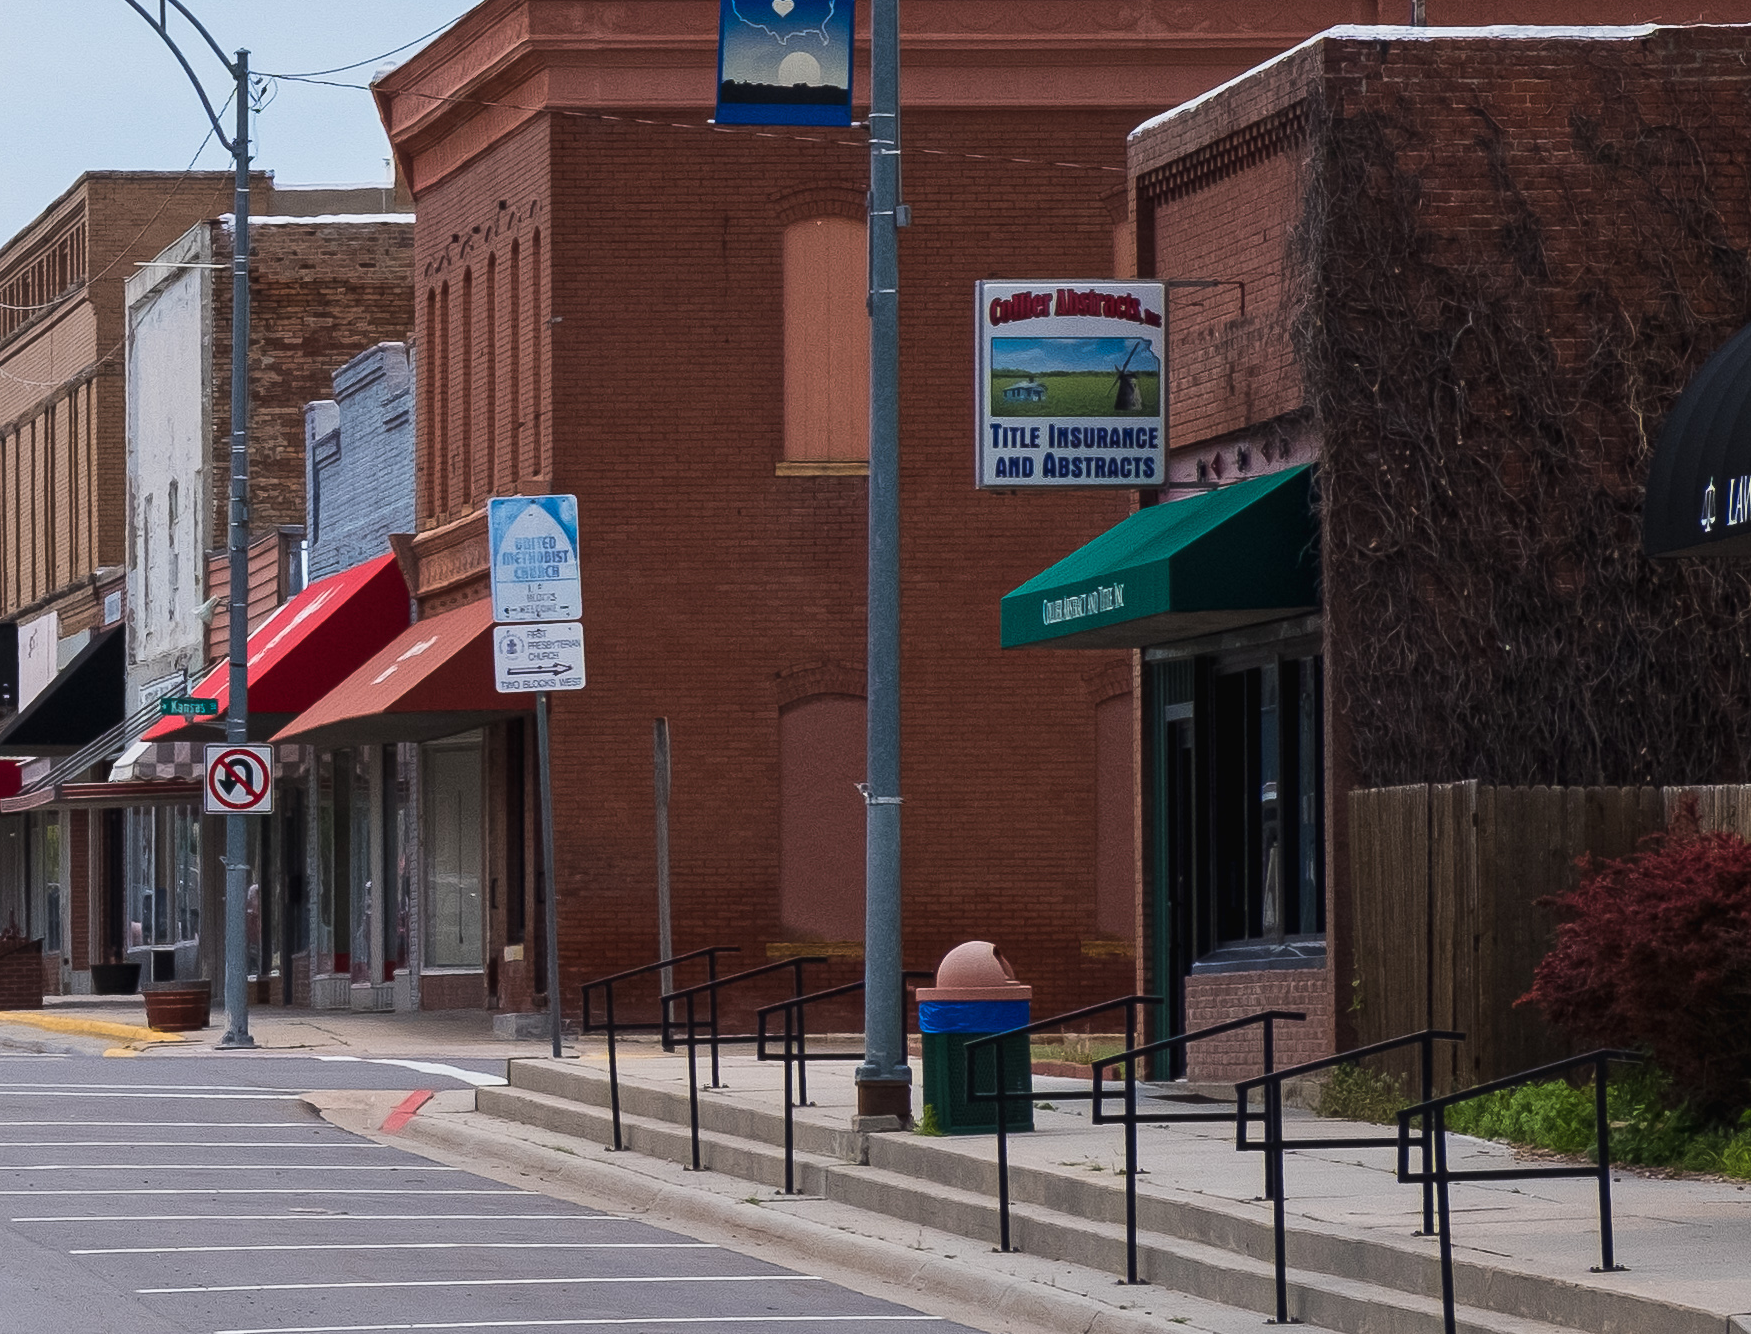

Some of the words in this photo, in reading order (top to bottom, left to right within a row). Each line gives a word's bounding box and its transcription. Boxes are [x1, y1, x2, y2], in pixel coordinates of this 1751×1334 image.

[989, 291, 1053, 327] Collier
[990, 423, 1040, 449] TITLE
[1048, 423, 1159, 449] INSURANCE
[1042, 452, 1155, 478] ABSTRACTS
[515, 536, 556, 550] UNITED
[502, 549, 569, 565] METHODIST
[514, 565, 560, 579] CHURCH
[528, 652, 559, 661] CHURCH
[523, 679, 556, 689] BLOCKS
[171, 702, 206, 713] Kansas
